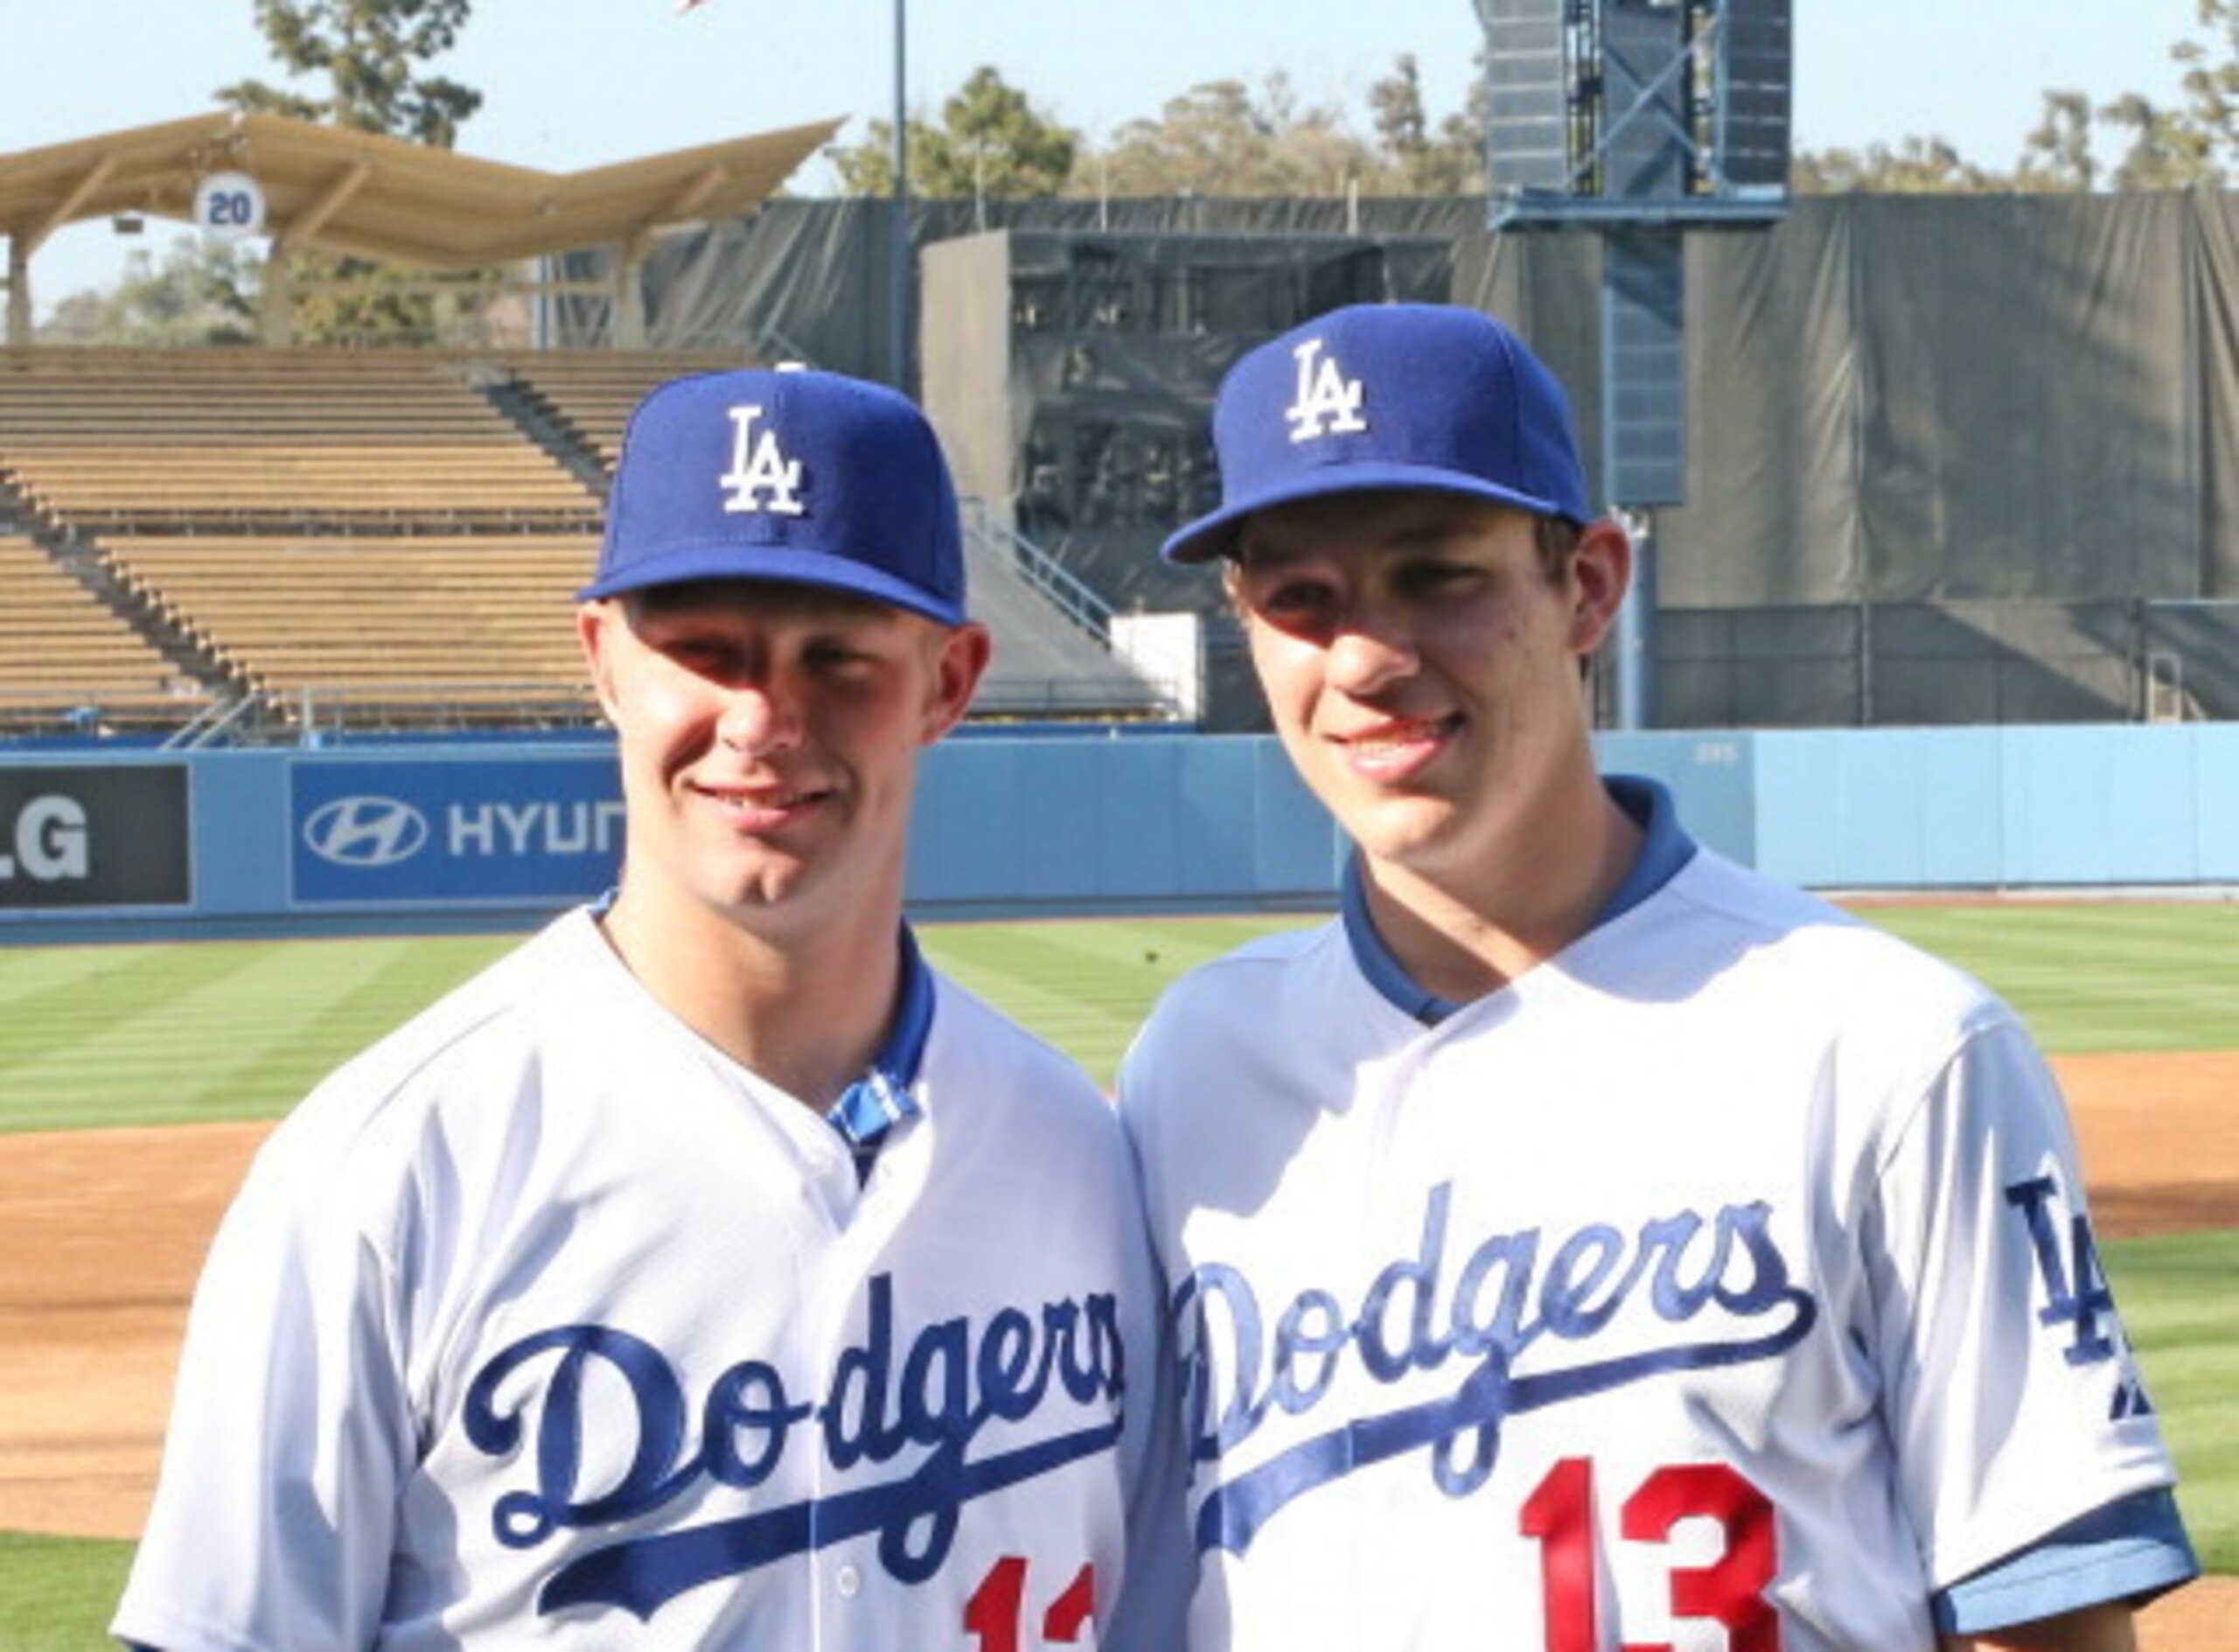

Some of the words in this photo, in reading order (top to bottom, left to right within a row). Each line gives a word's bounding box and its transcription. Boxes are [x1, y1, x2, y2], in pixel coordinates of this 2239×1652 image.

[209, 192, 252, 225] 20
[1285, 338, 1367, 443] LA
[720, 405, 804, 516] LA
[1170, 1179, 1789, 1497] Dodgers
[1519, 1454, 1780, 1652] 13
